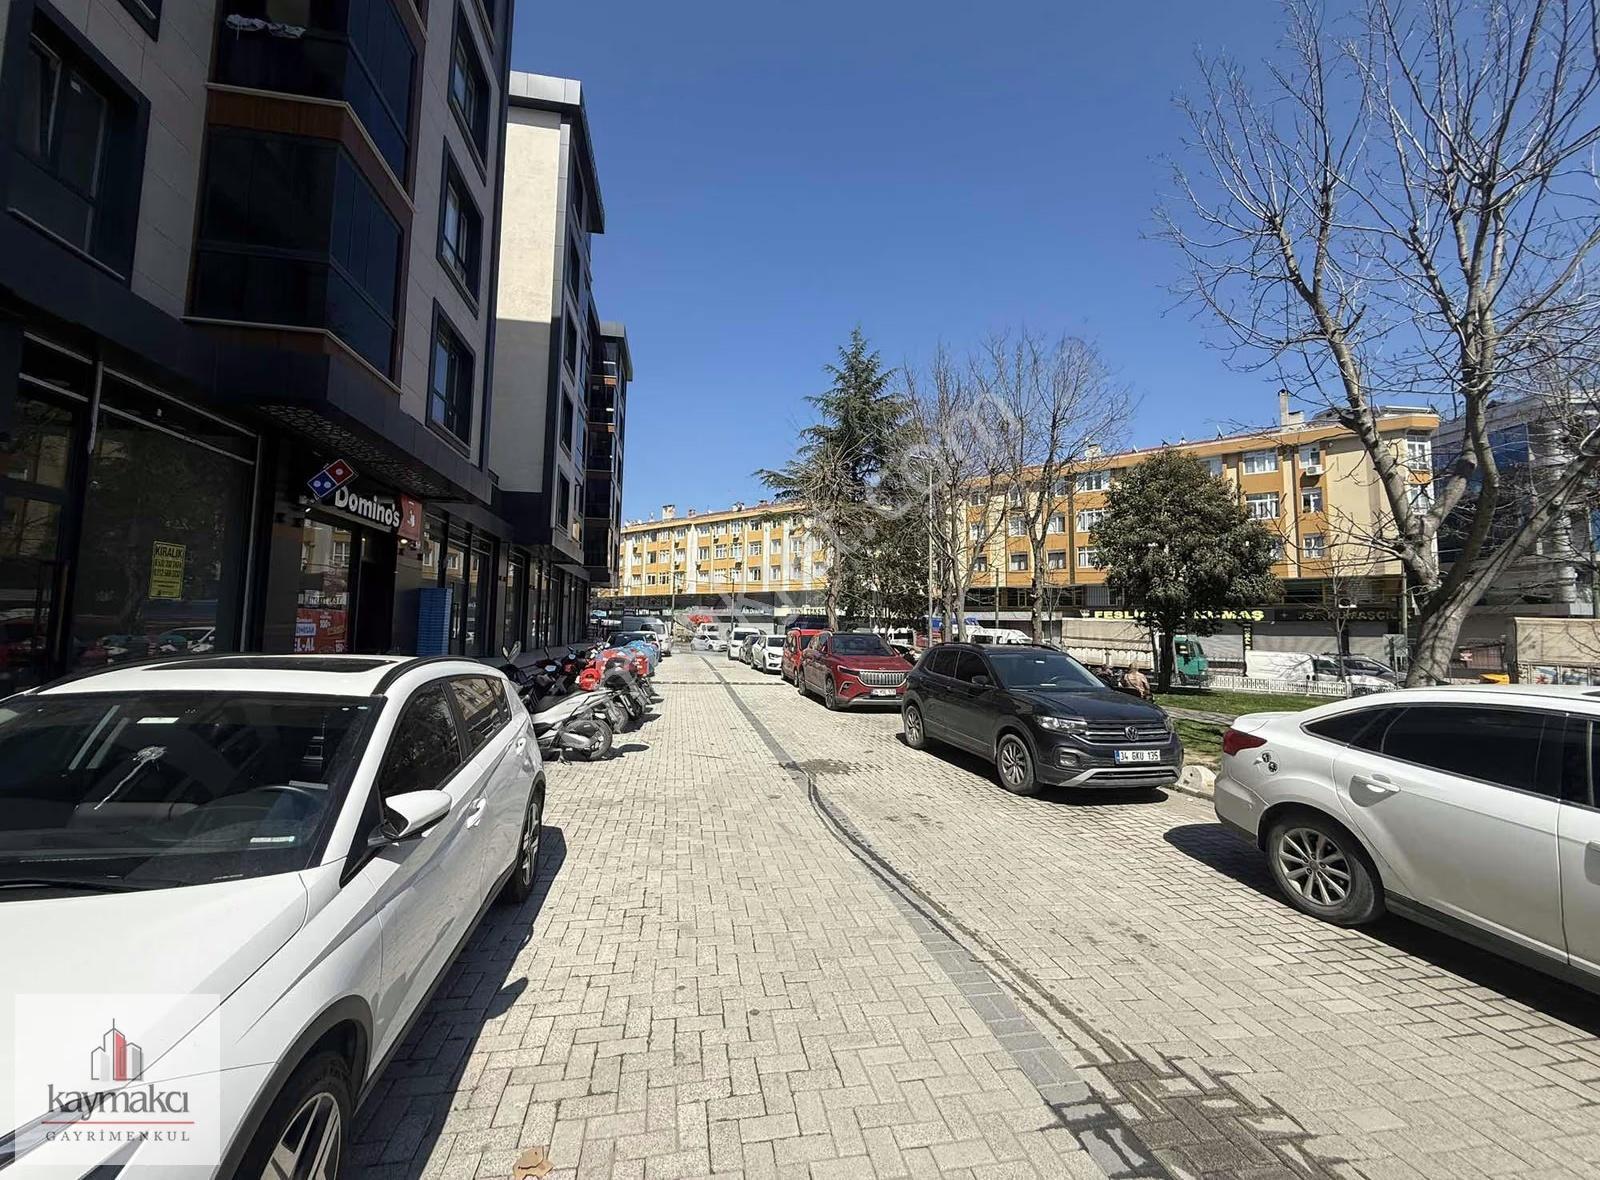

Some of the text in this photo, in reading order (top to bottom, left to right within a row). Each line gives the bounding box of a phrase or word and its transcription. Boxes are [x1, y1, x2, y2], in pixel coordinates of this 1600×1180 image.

[334, 485, 400, 528] Domino's
[155, 545, 184, 559] KIRALIK
[1120, 751, 1129, 761] 34
[1147, 751, 1159, 761] 135
